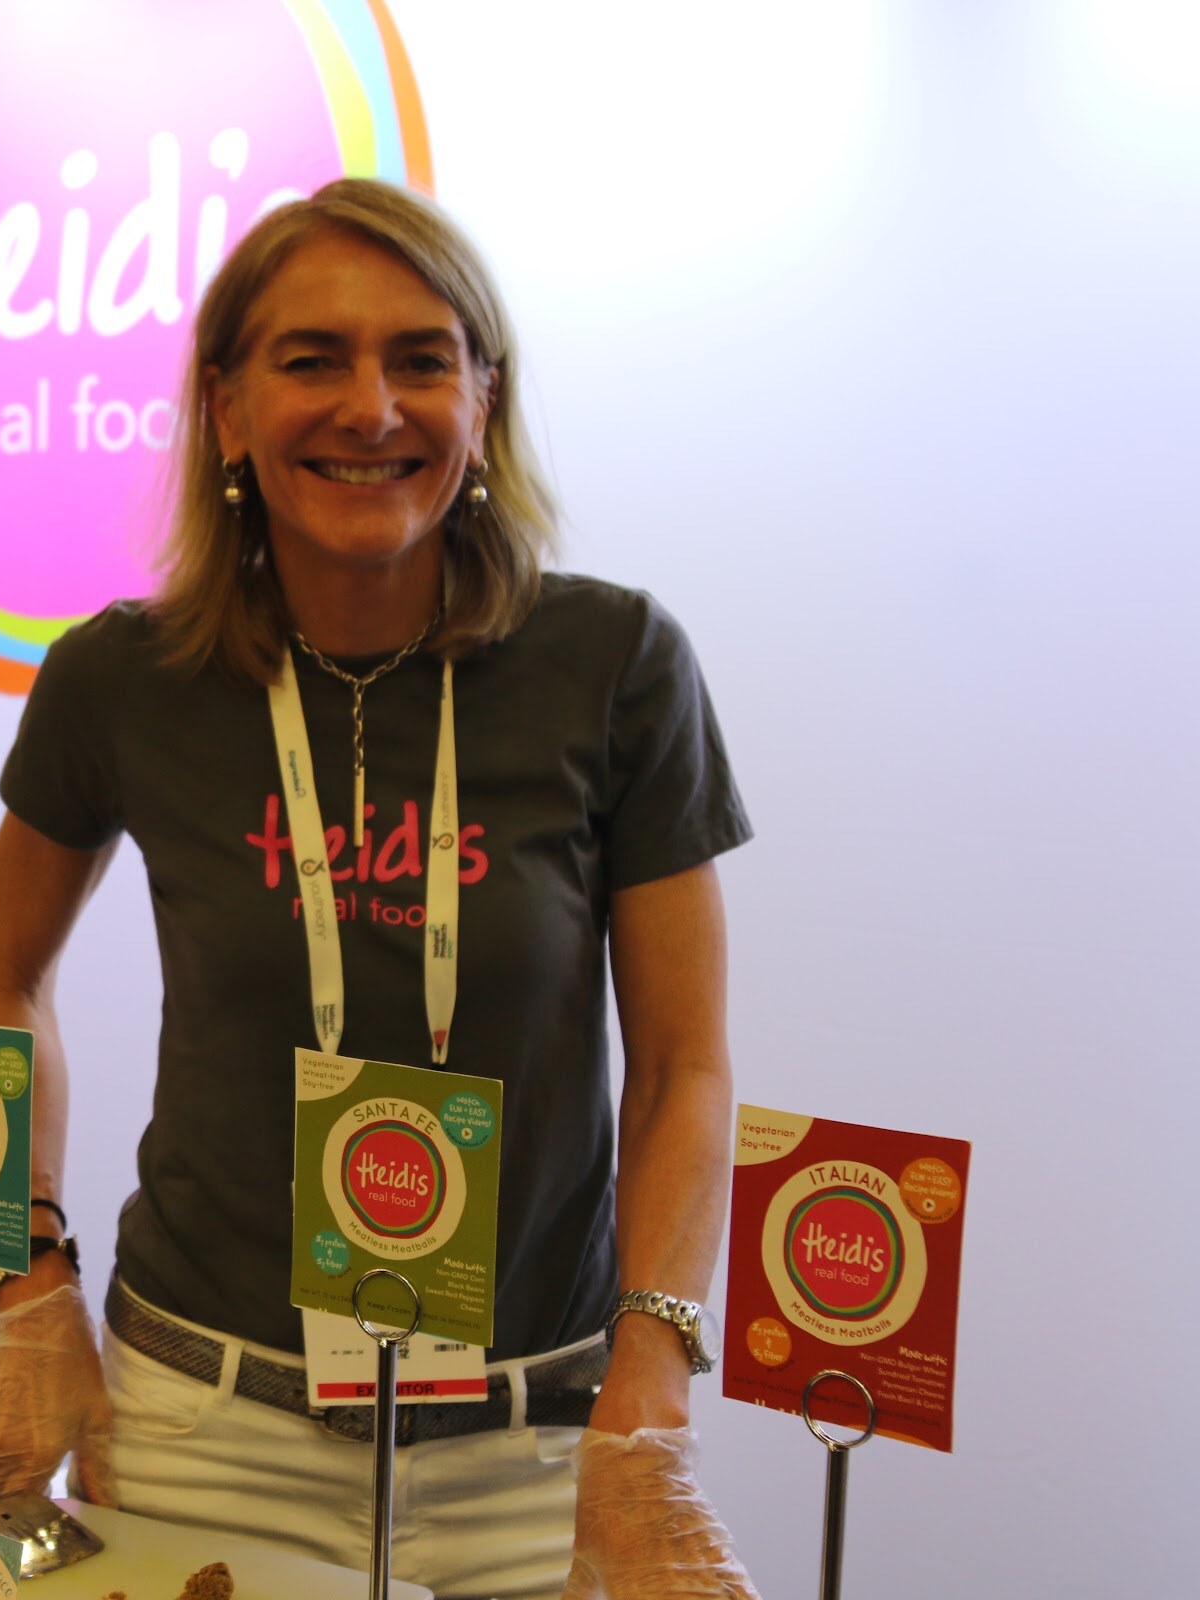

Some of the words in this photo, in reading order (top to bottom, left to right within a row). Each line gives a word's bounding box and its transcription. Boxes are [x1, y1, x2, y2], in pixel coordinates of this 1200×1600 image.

[73, 375, 179, 454] foo
[369, 897, 426, 927] foo
[302, 1057, 344, 1071] Vegetarian
[302, 1068, 345, 1082] Wheat-free
[302, 1078, 335, 1091] Soy-free
[456, 1096, 480, 1106] Watch
[448, 1104, 463, 1113] FUN
[468, 1107, 487, 1118] EASY
[353, 1103, 410, 1123] SANTA
[415, 1114, 437, 1136] FE
[444, 1113, 466, 1125] Recipe
[742, 1122, 796, 1138] Vegetarian
[740, 1138, 782, 1152] Soy-free
[809, 1165, 887, 1196] ITALIAN
[368, 1191, 388, 1203] real
[391, 1192, 416, 1208] food
[348, 1220, 389, 1251] Meatless
[391, 1235, 437, 1254] Meatballs
[443, 1257, 465, 1269] Made
[436, 1268, 469, 1280] Non-GMO
[469, 1274, 486, 1283] Corn
[815, 1266, 837, 1280] real
[840, 1268, 870, 1287] food
[447, 1280, 466, 1290] Black
[466, 1284, 485, 1294] Beans
[425, 1286, 445, 1298] Sweet
[446, 1290, 460, 1299] Red
[461, 1293, 485, 1306] Peppers
[367, 1300, 386, 1312] Keep
[387, 1303, 412, 1315] Frozen
[460, 1303, 484, 1314] Cheese
[790, 1300, 836, 1336] Meatless
[839, 1318, 892, 1338] Meatballs
[900, 1346, 923, 1360] Made
[860, 1353, 897, 1367] Non-GMO
[922, 1366, 947, 1378] Wheat
[878, 1368, 911, 1382] Sundried
[911, 1375, 945, 1388] Tomatoes
[356, 1384, 434, 1397] EXITOR
[883, 1380, 917, 1396] Parmesan
[917, 1387, 945, 1400] Cheese
[877, 1390, 899, 1403] Fresh
[922, 1399, 946, 1413] Garlic
